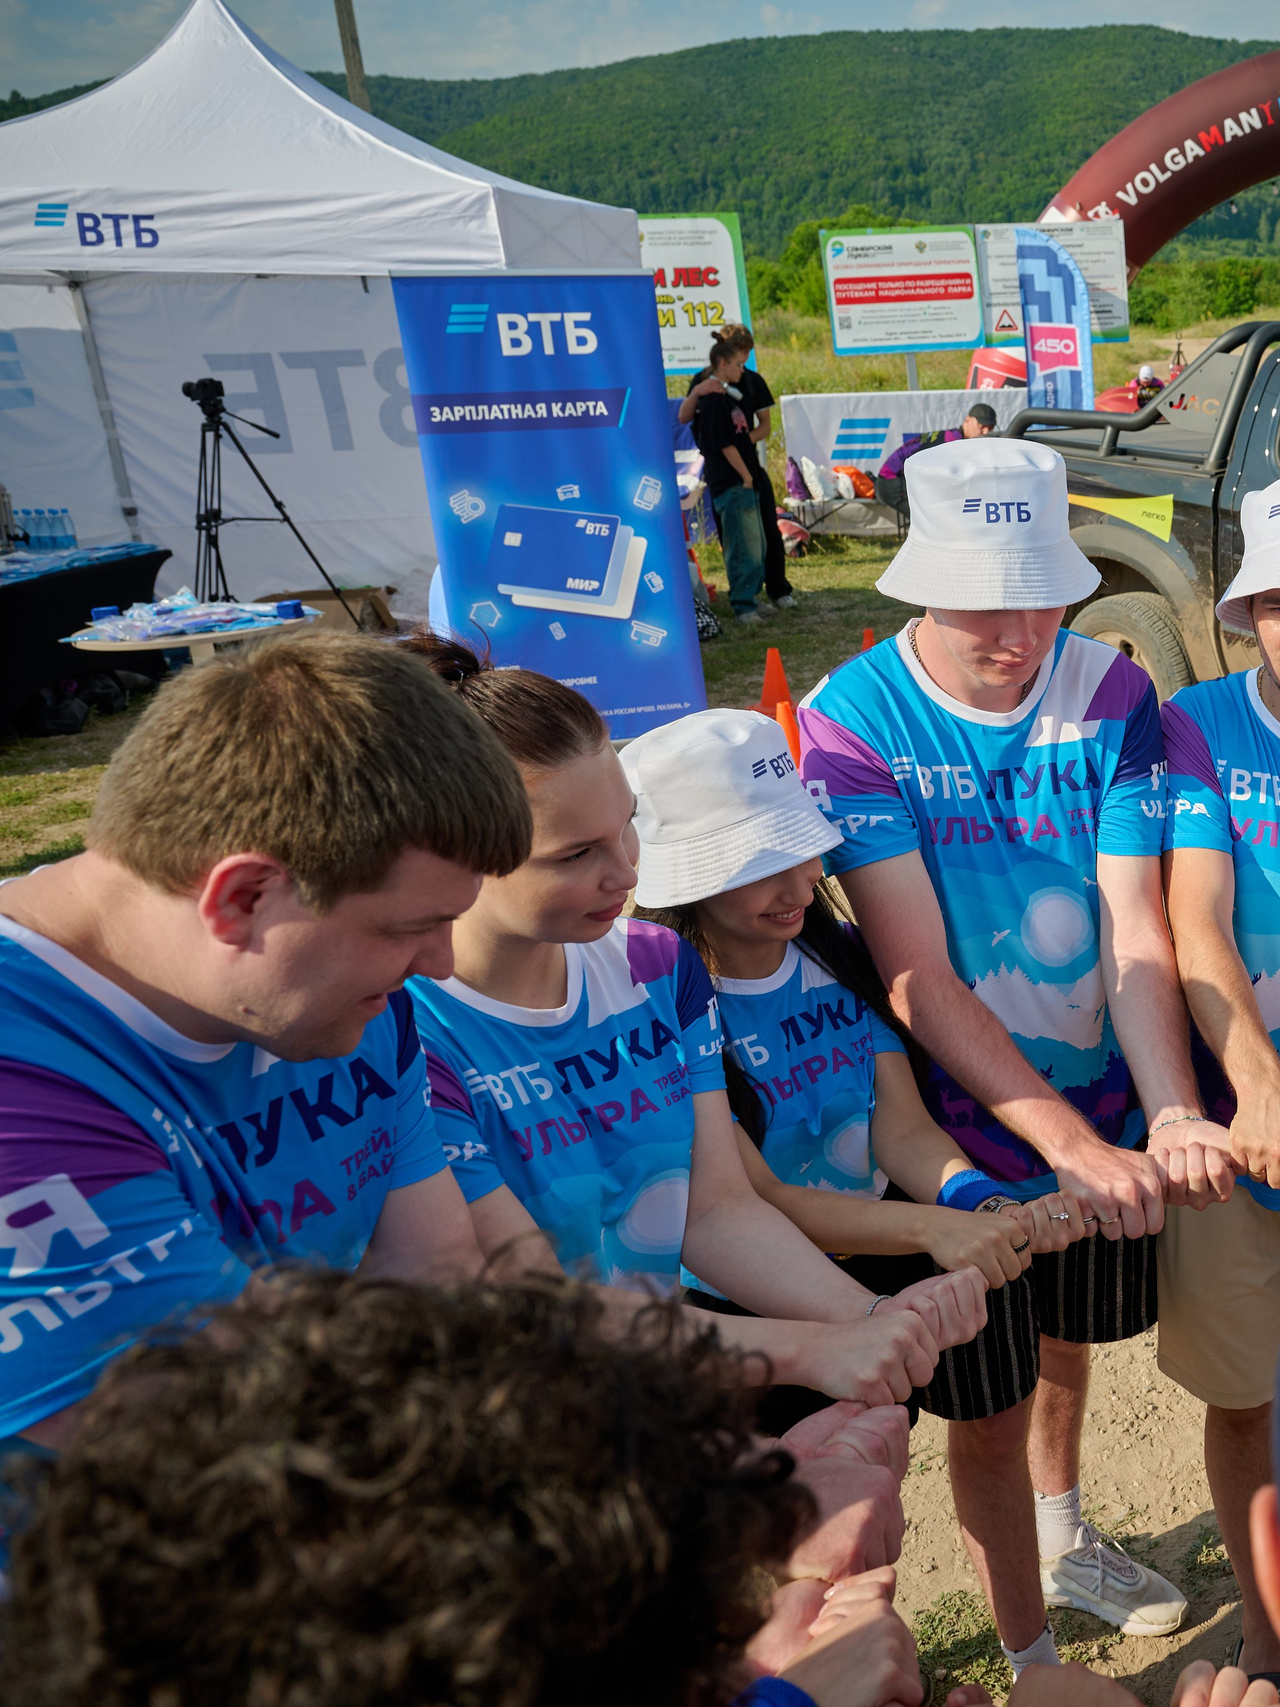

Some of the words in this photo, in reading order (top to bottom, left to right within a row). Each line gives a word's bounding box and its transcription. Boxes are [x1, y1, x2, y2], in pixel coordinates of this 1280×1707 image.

[75, 211, 160, 249] ВТБ
[671, 266, 720, 288] ЛЕС
[682, 300, 726, 327] 112
[496, 310, 598, 357] ВТБ
[1033, 338, 1075, 355] 450
[430, 402, 548, 423] ЗАРПЛАТНАЯ
[551, 400, 609, 418] КАРТА
[1169, 392, 1221, 415] JAC
[985, 501, 1032, 524] ВТБ
[1141, 509, 1166, 522] легко
[585, 522, 610, 537] ВТБ
[566, 577, 600, 592] МИР
[769, 751, 795, 779] ВТБ
[919, 764, 971, 800] ВТБ
[986, 757, 1100, 801] ЛУКА
[929, 813, 1062, 847] УЛЬТРА
[483, 1061, 553, 1112] ВТБ
[553, 1018, 681, 1095] ЛУКА
[723, 1033, 770, 1072] ТБ
[511, 1086, 661, 1163] УЛЬТРА
[653, 1061, 691, 1092] ТРЕЙ
[358, 1152, 396, 1190] БАЙ
